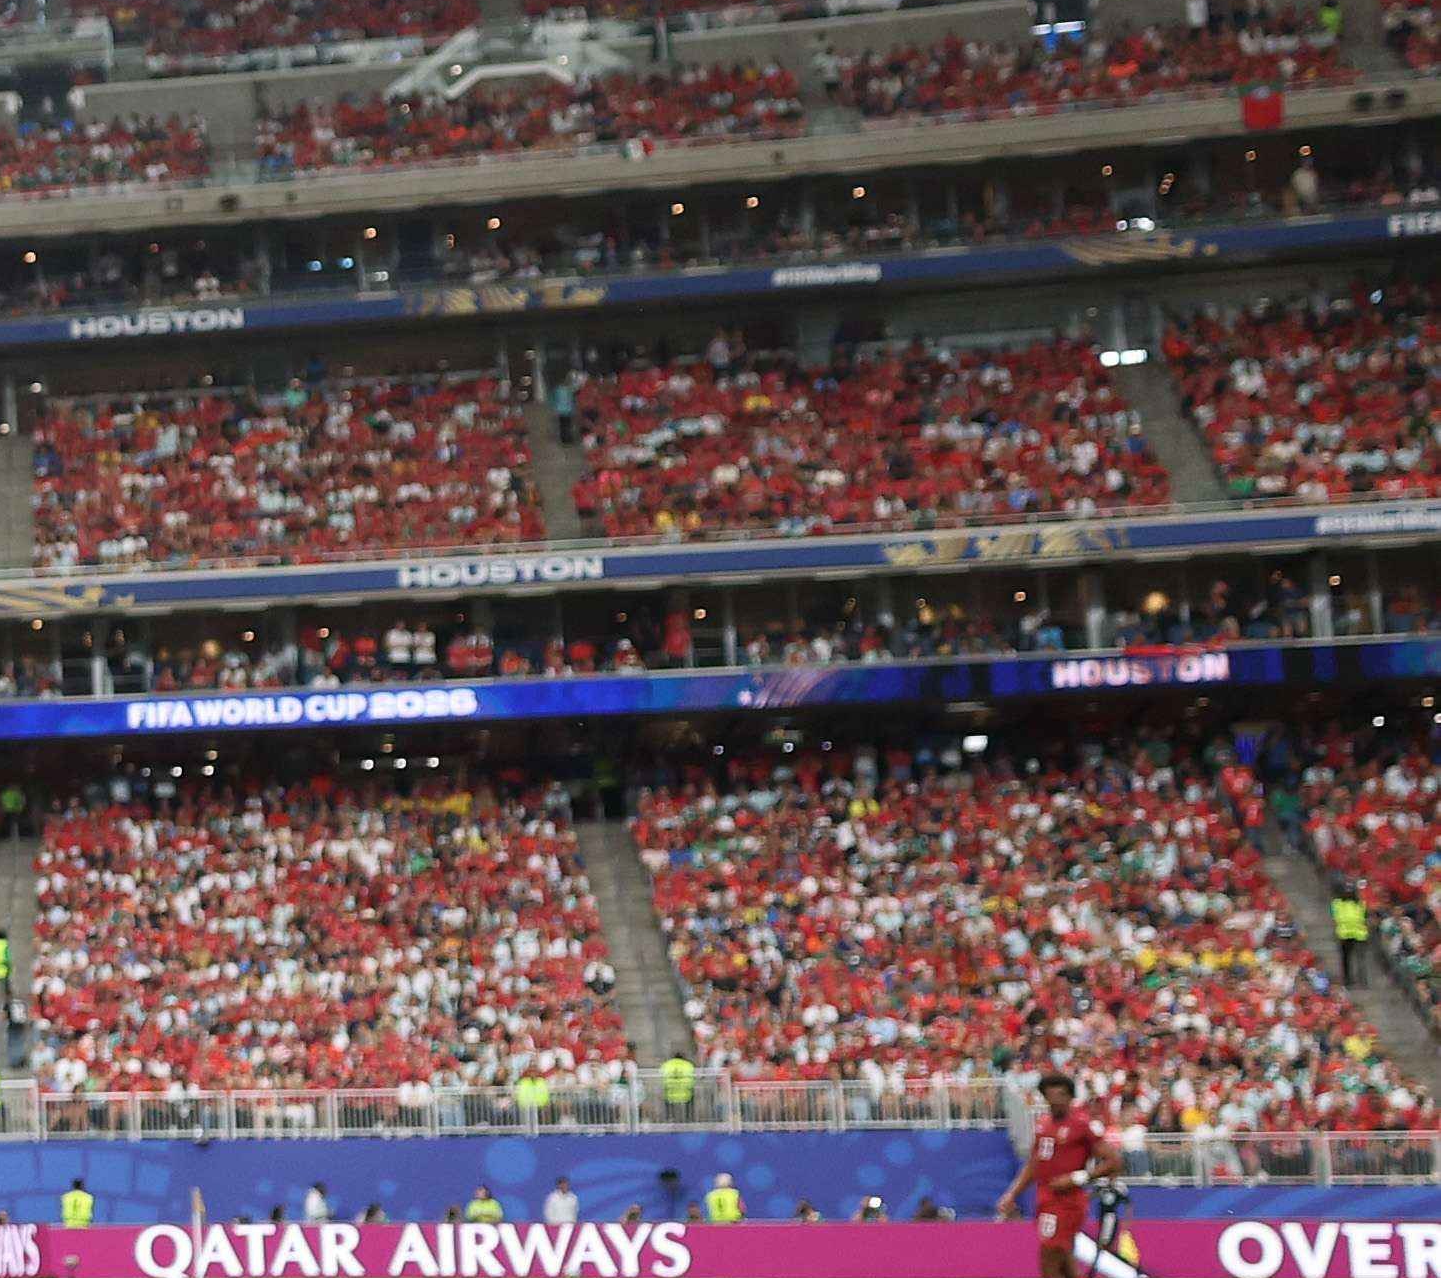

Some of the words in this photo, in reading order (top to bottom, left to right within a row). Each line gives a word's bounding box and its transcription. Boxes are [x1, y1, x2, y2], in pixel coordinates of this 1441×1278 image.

[70, 307, 246, 339] HOUSTON
[397, 556, 604, 588] HOUSTON
[1051, 652, 1230, 689] HOUSTON
[126, 700, 193, 729] FIFA
[192, 695, 303, 727] WORLD
[304, 691, 368, 722] CUP
[368, 687, 478, 720] 2026
[388, 1222, 692, 1278] AIRWAYS
